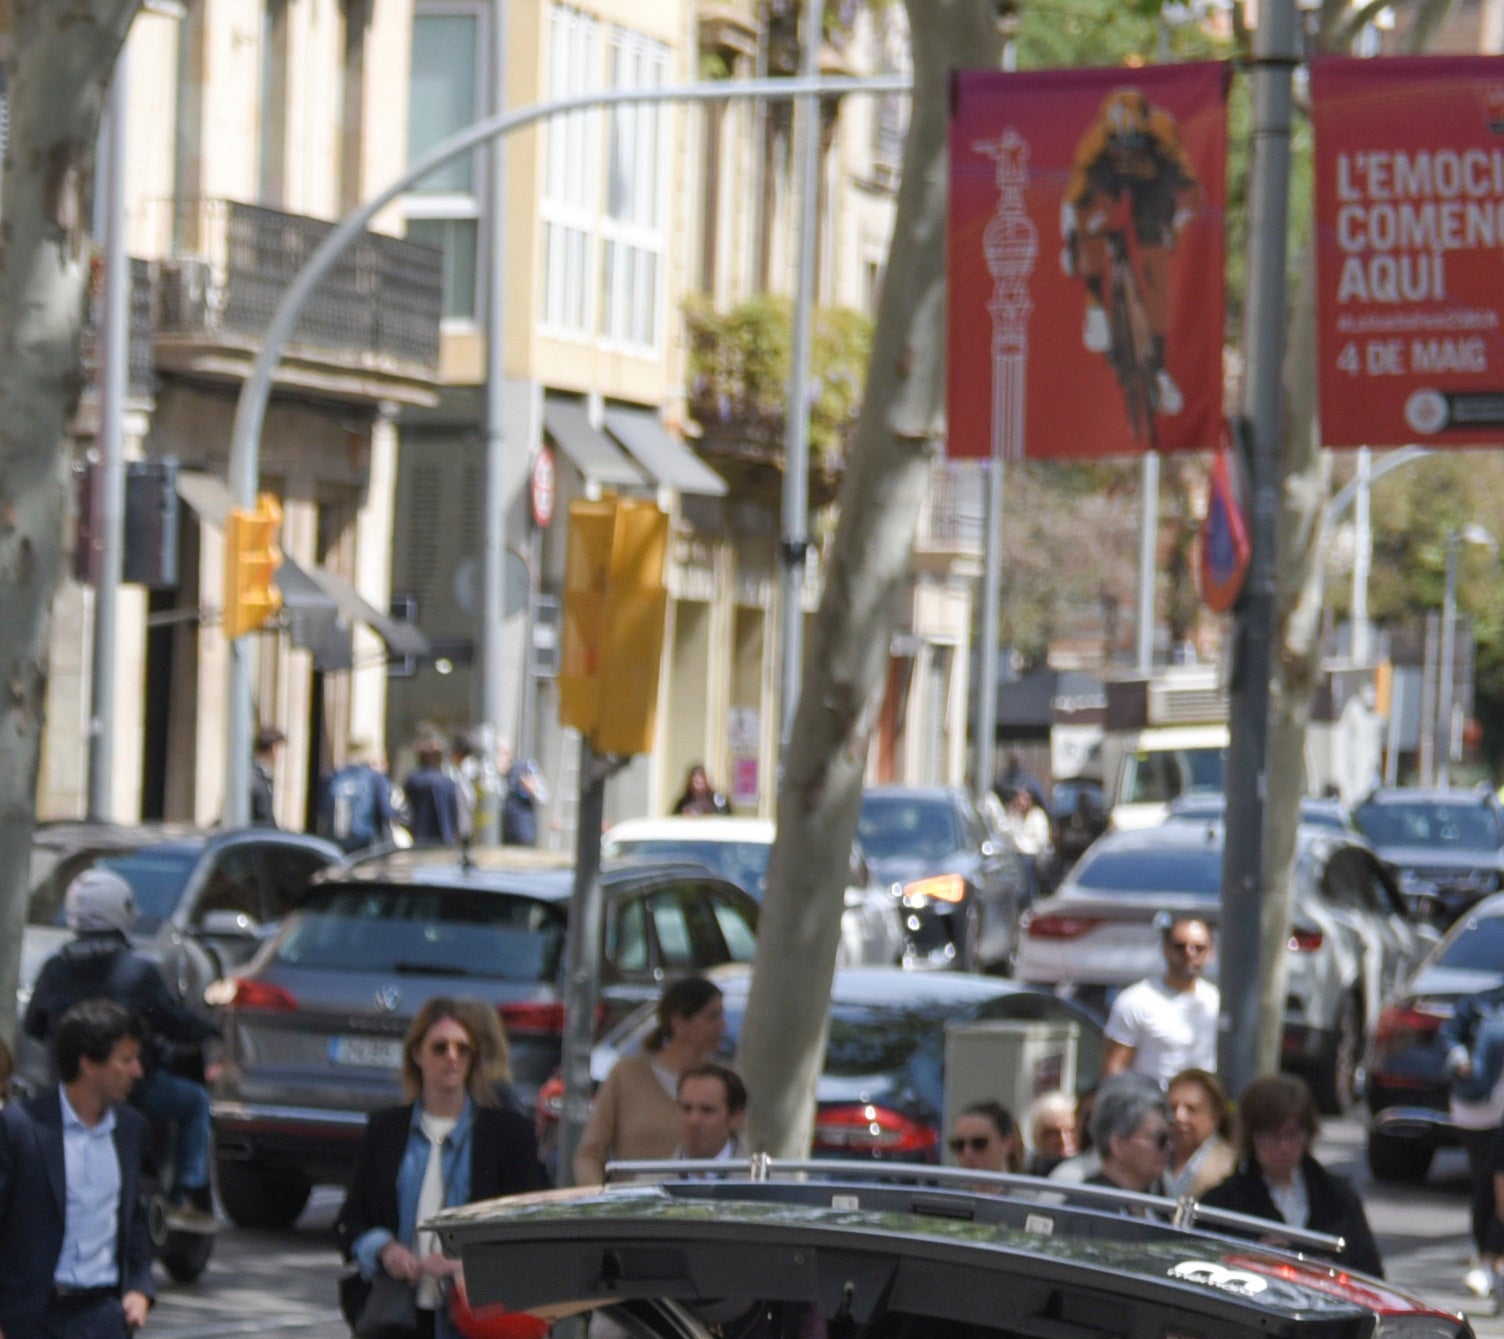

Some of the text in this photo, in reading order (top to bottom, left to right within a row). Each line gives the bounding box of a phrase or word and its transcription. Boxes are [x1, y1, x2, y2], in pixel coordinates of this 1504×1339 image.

[1338, 201, 1504, 251] COMEN
[1337, 336, 1486, 375] 4 DE MAIG
